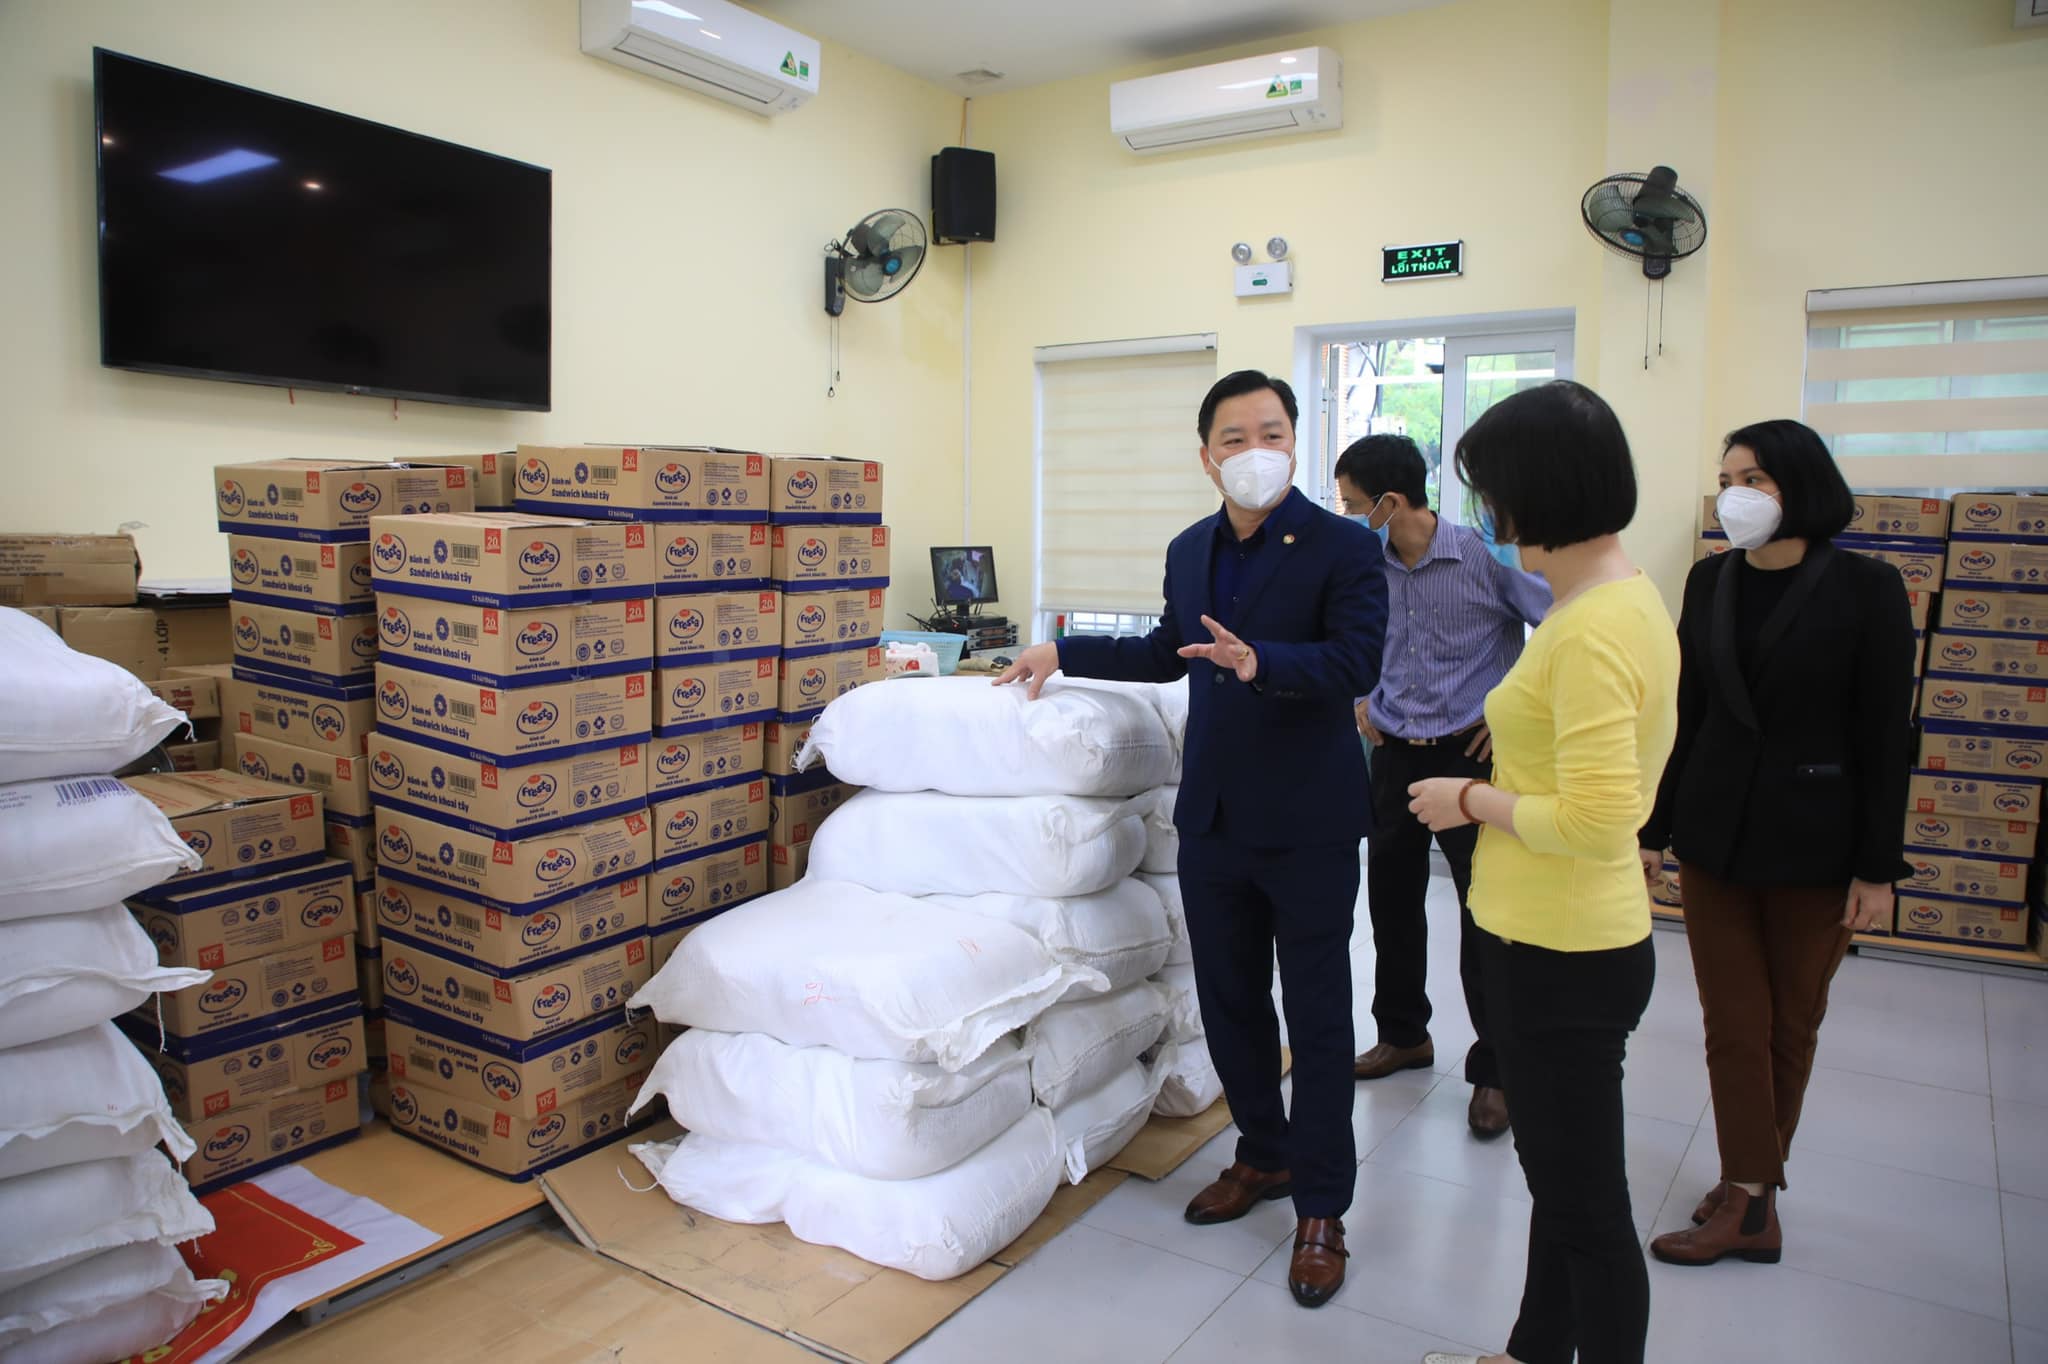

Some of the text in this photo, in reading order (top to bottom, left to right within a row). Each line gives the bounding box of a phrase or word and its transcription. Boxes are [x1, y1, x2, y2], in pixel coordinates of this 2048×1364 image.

[1397, 247, 1446, 259] EXIT
[1391, 257, 1452, 274] LỐI THOÁT
[625, 456, 634, 465] 20
[748, 462, 759, 473] 20
[522, 468, 545, 483] Fresta
[659, 473, 686, 485] Fresta
[791, 479, 814, 491] Fresta
[345, 488, 376, 504] Fresta
[552, 488, 580, 498] Sandwich
[487, 536, 498, 547] 20
[628, 532, 641, 542] 20
[752, 531, 763, 541] 20
[376, 543, 401, 560] Fresta
[524, 549, 555, 565] Fresta
[669, 544, 694, 557] Fresta
[802, 546, 824, 558] Fresta
[410, 568, 472, 584] Sandwich khoai tây
[761, 599, 773, 610] 20
[629, 607, 640, 618] 20
[800, 612, 822, 623] Fresta
[383, 617, 406, 635] Fresta
[485, 617, 496, 627] 20
[674, 616, 700, 629] Fresta
[521, 629, 552, 645] Fresta
[157, 644, 169, 655] 4
[414, 643, 442, 656] Sandwich
[443, 646, 460, 659] khoai
[759, 663, 771, 673] 20
[802, 675, 822, 687] Fresta
[629, 683, 641, 693] 20
[677, 686, 702, 699] Fresta
[381, 690, 404, 708] Fresta
[482, 698, 494, 708] 20
[522, 708, 553, 725] Fresta
[412, 717, 440, 731] Sandwich
[744, 727, 756, 738] 20
[623, 751, 634, 760] 20
[660, 751, 686, 764] Fresta
[374, 761, 400, 779] Fresta
[484, 772, 495, 781] 20
[408, 788, 438, 803] Sandwich
[522, 781, 552, 797] Fresta
[669, 816, 694, 830] Fresta
[383, 835, 409, 854] Fresta
[495, 848, 509, 858] 20
[541, 854, 571, 871] Fresta
[666, 882, 690, 897] Fresta
[526, 919, 556, 937] Fresta
[204, 985, 241, 1003] Fresta
[537, 990, 566, 1008] Fresta
[531, 1119, 561, 1138] Fresta
[209, 1131, 244, 1151] Fresta
